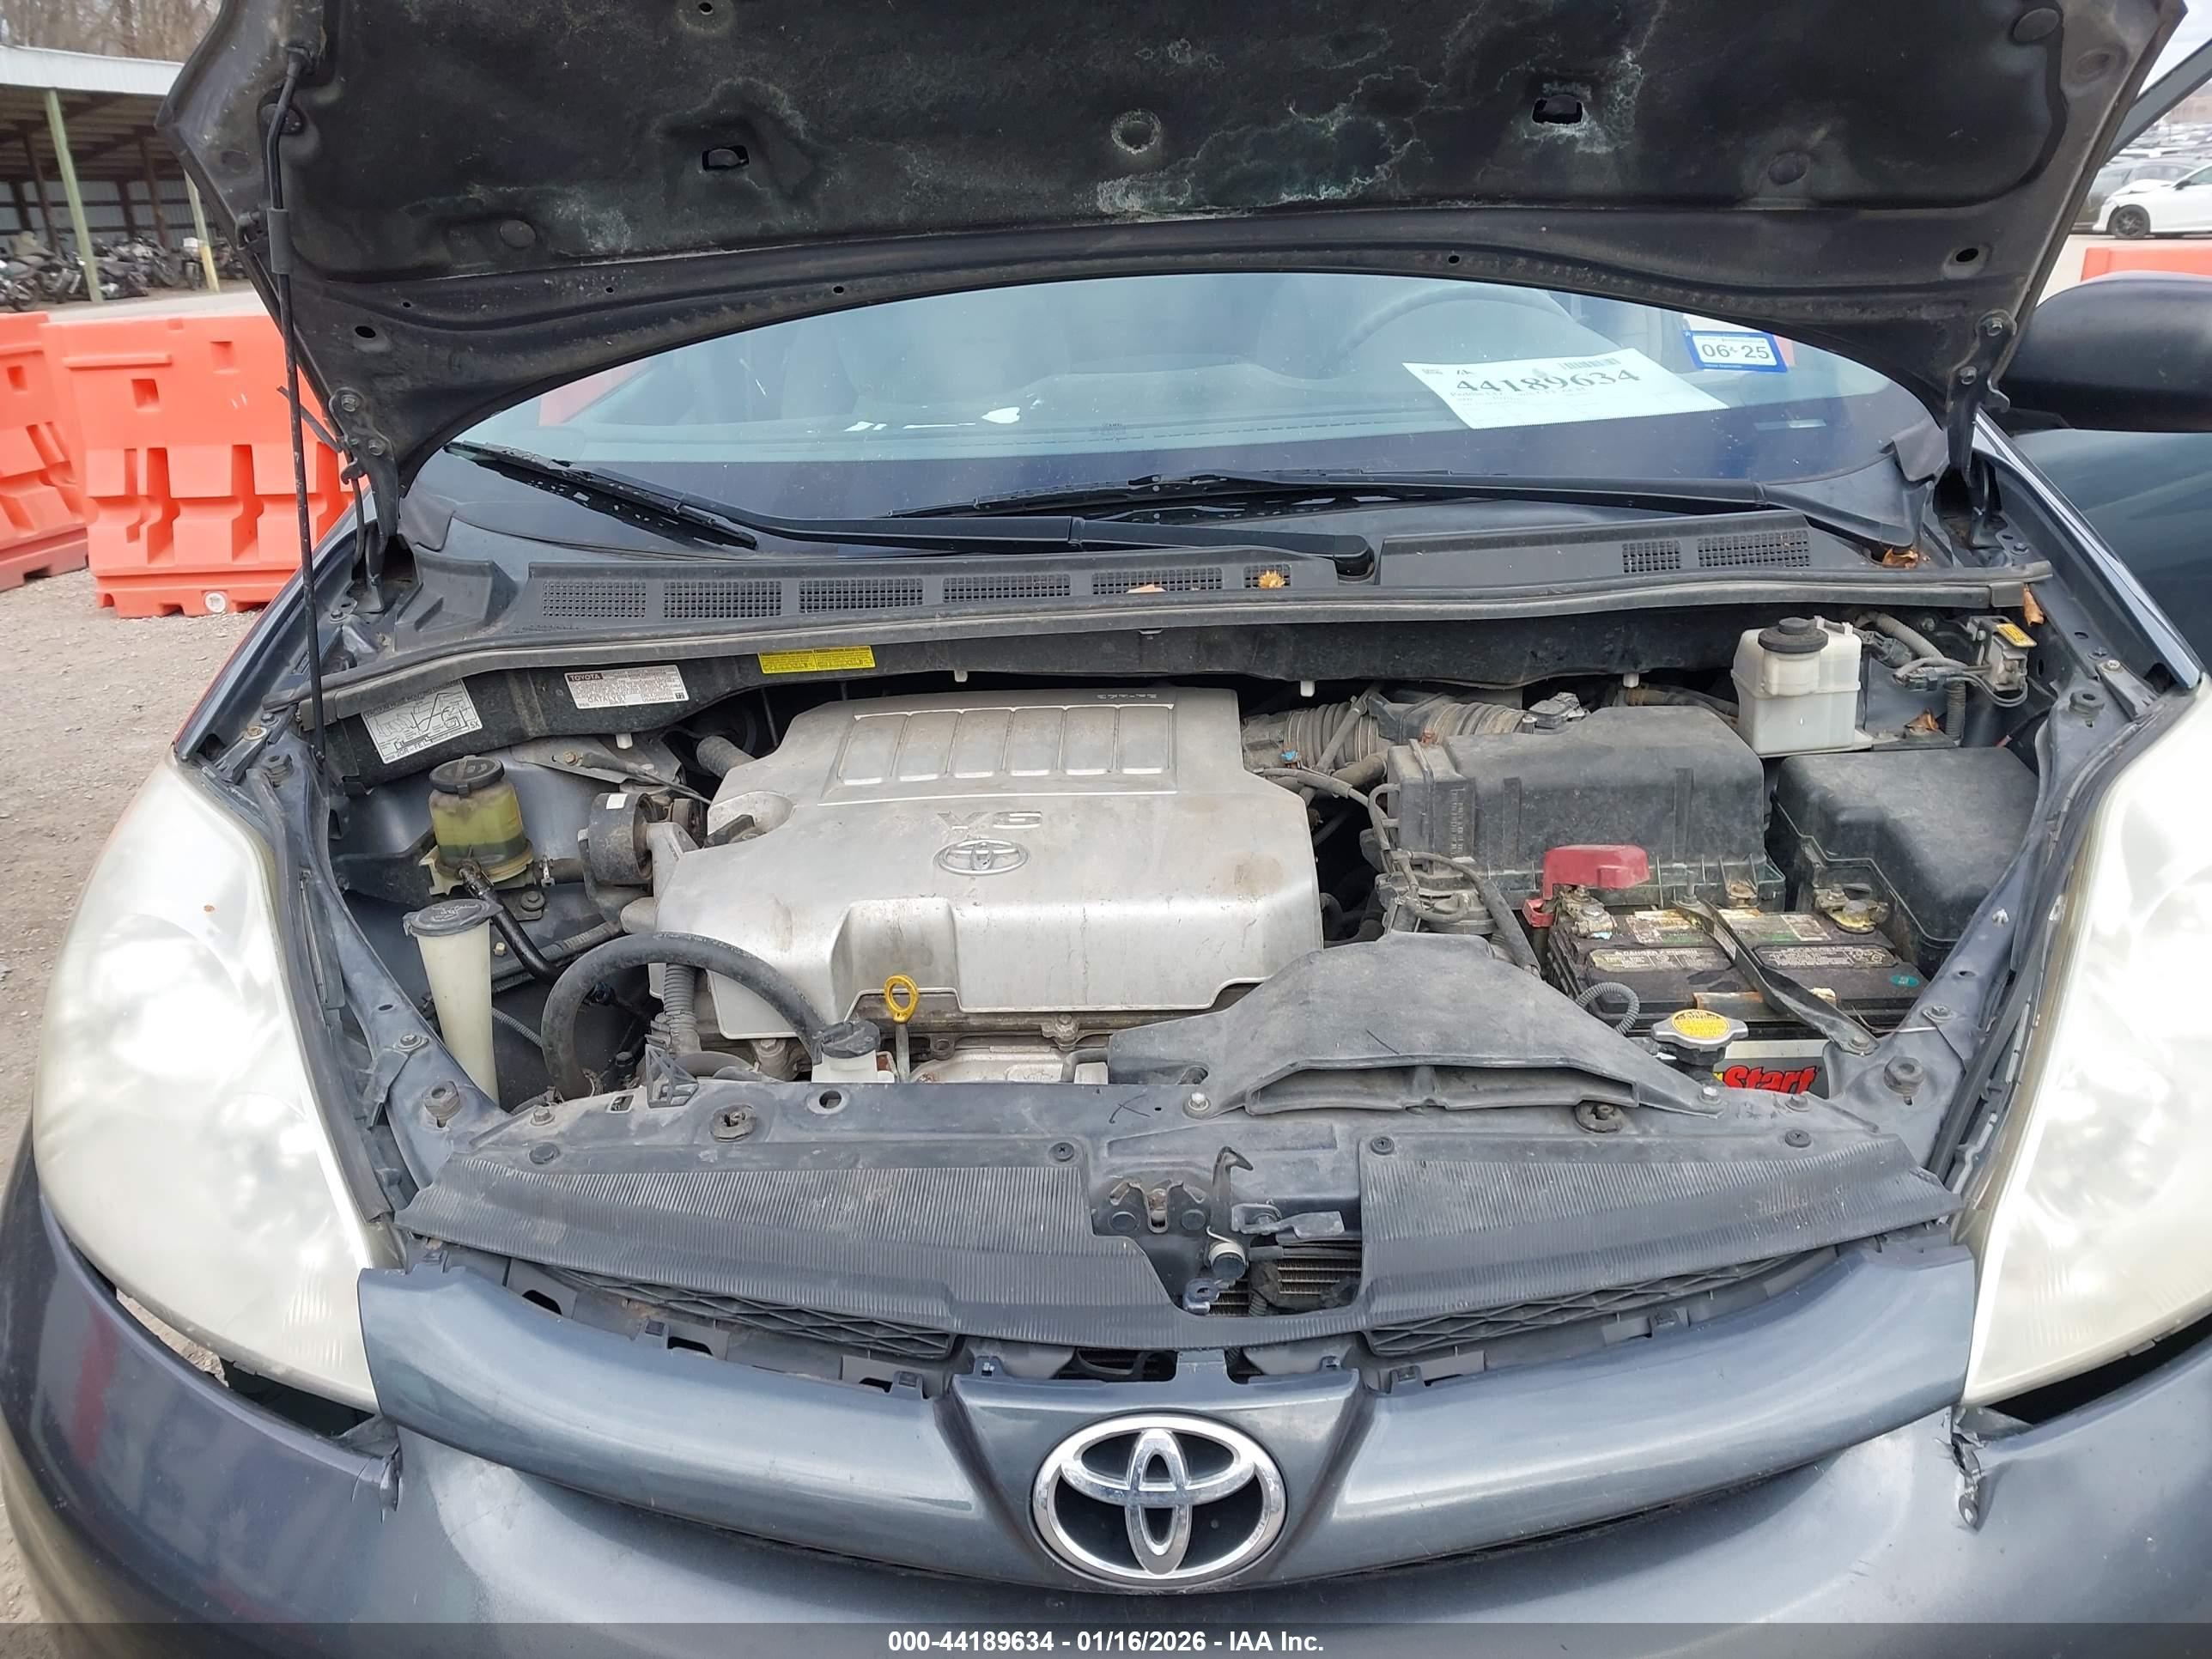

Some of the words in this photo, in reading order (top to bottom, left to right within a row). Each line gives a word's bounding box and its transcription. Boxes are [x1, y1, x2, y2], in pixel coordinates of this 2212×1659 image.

[1701, 343, 1730, 357] 06
[1741, 344, 1770, 359] 25
[1456, 368, 1642, 393] 44189634
[937, 811, 1042, 830] V6
[1713, 1065, 1817, 1095] Start
